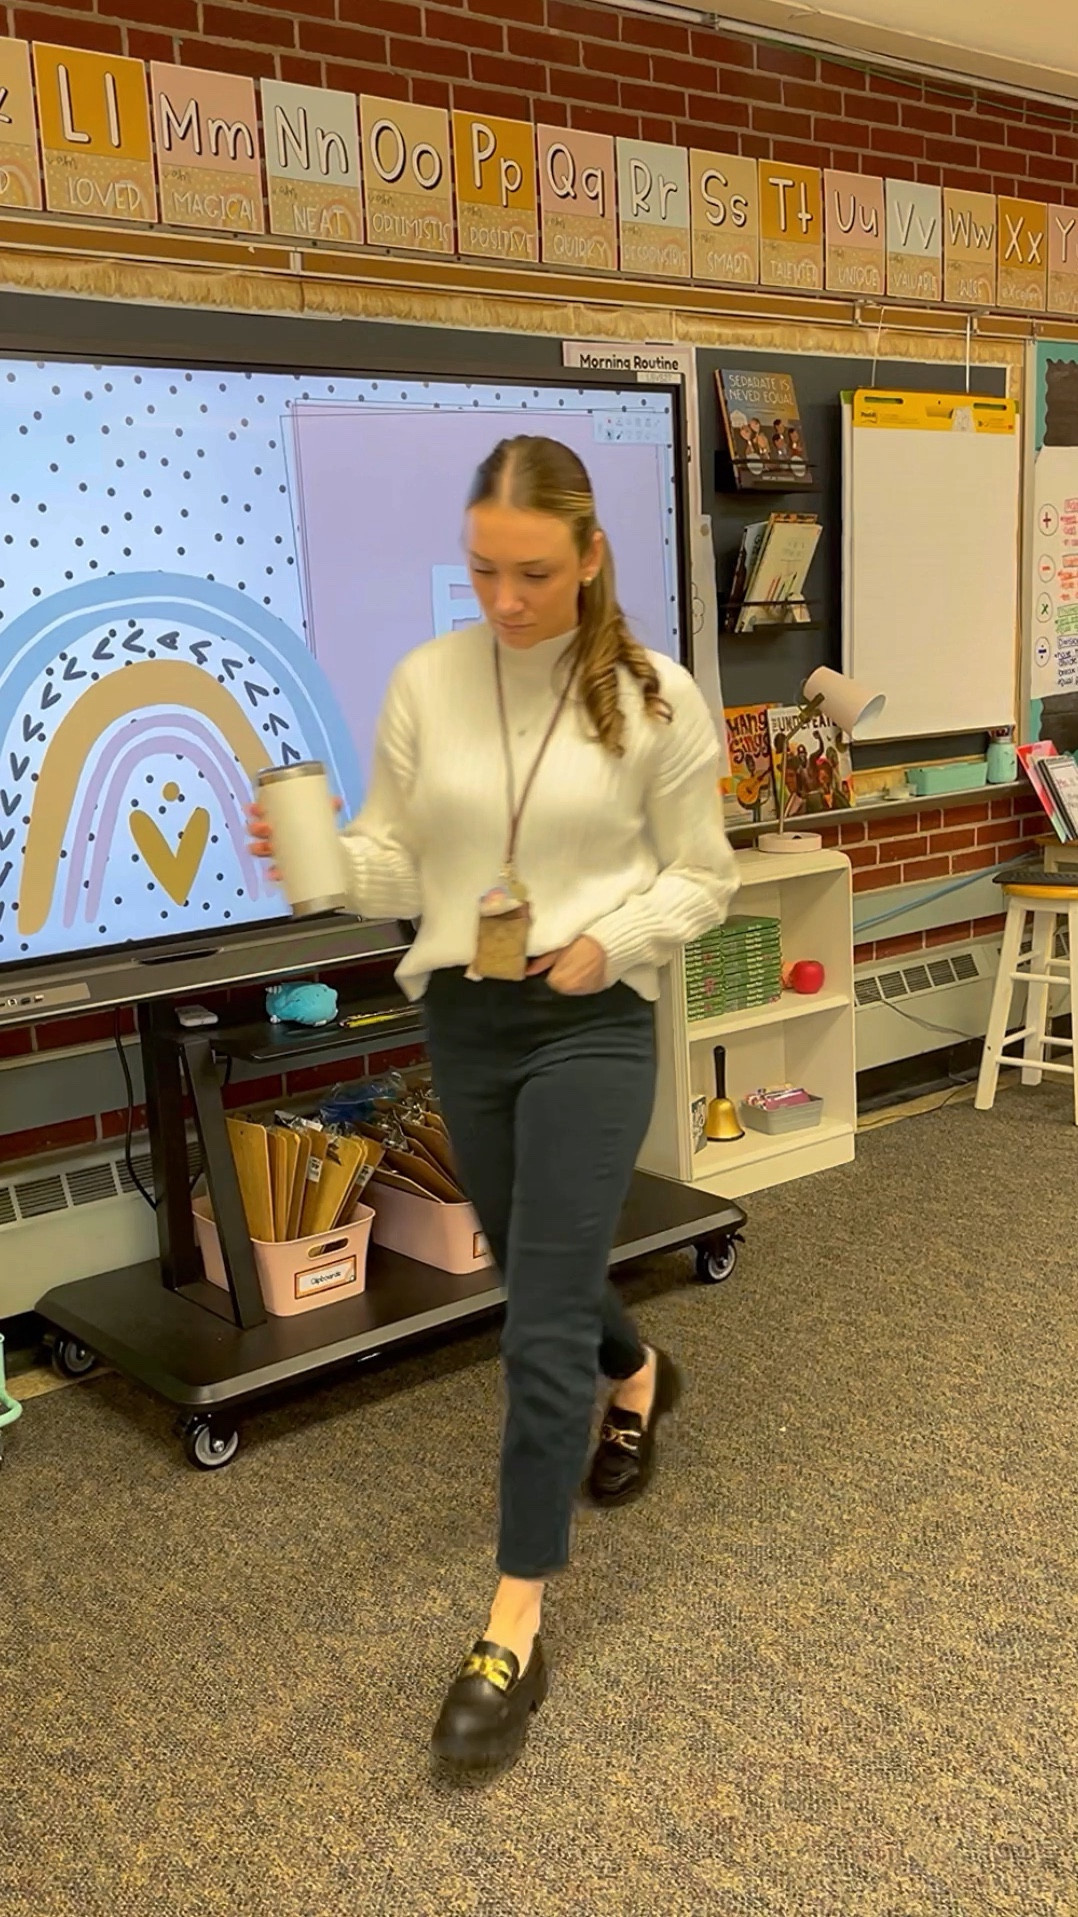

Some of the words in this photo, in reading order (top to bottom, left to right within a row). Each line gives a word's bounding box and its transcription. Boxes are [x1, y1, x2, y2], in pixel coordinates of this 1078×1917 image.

[159, 92, 254, 160] Mm
[275, 105, 349, 175] Nn
[370, 118, 442, 190] Oo
[471, 122, 523, 208] Pp
[68, 176, 141, 211] LOVED
[546, 142, 605, 217] Qq
[629, 157, 678, 220] Rr
[700, 169, 748, 227] Ss
[172, 190, 257, 222] MAGICAL
[293, 203, 345, 236] NEAT
[372, 213, 450, 241] OPTIMISTIC
[768, 177, 813, 234] Tt
[834, 190, 879, 237] Uu
[894, 200, 937, 249] Vv
[469, 226, 534, 252] POSITIVE
[553, 234, 605, 259] QUIRKY
[949, 207, 994, 250] Ww
[1004, 213, 1043, 265] Xx
[1055, 216, 1078, 262] Y
[707, 251, 750, 273] SMART
[838, 267, 879, 287] UNIQUE
[580, 354, 631, 370] Morning
[633, 356, 679, 370] Routine
[728, 374, 776, 390] SEPARATE
[780, 379, 790, 391] IS
[729, 388, 760, 402] NEVER
[762, 391, 794, 405] EQUAL
